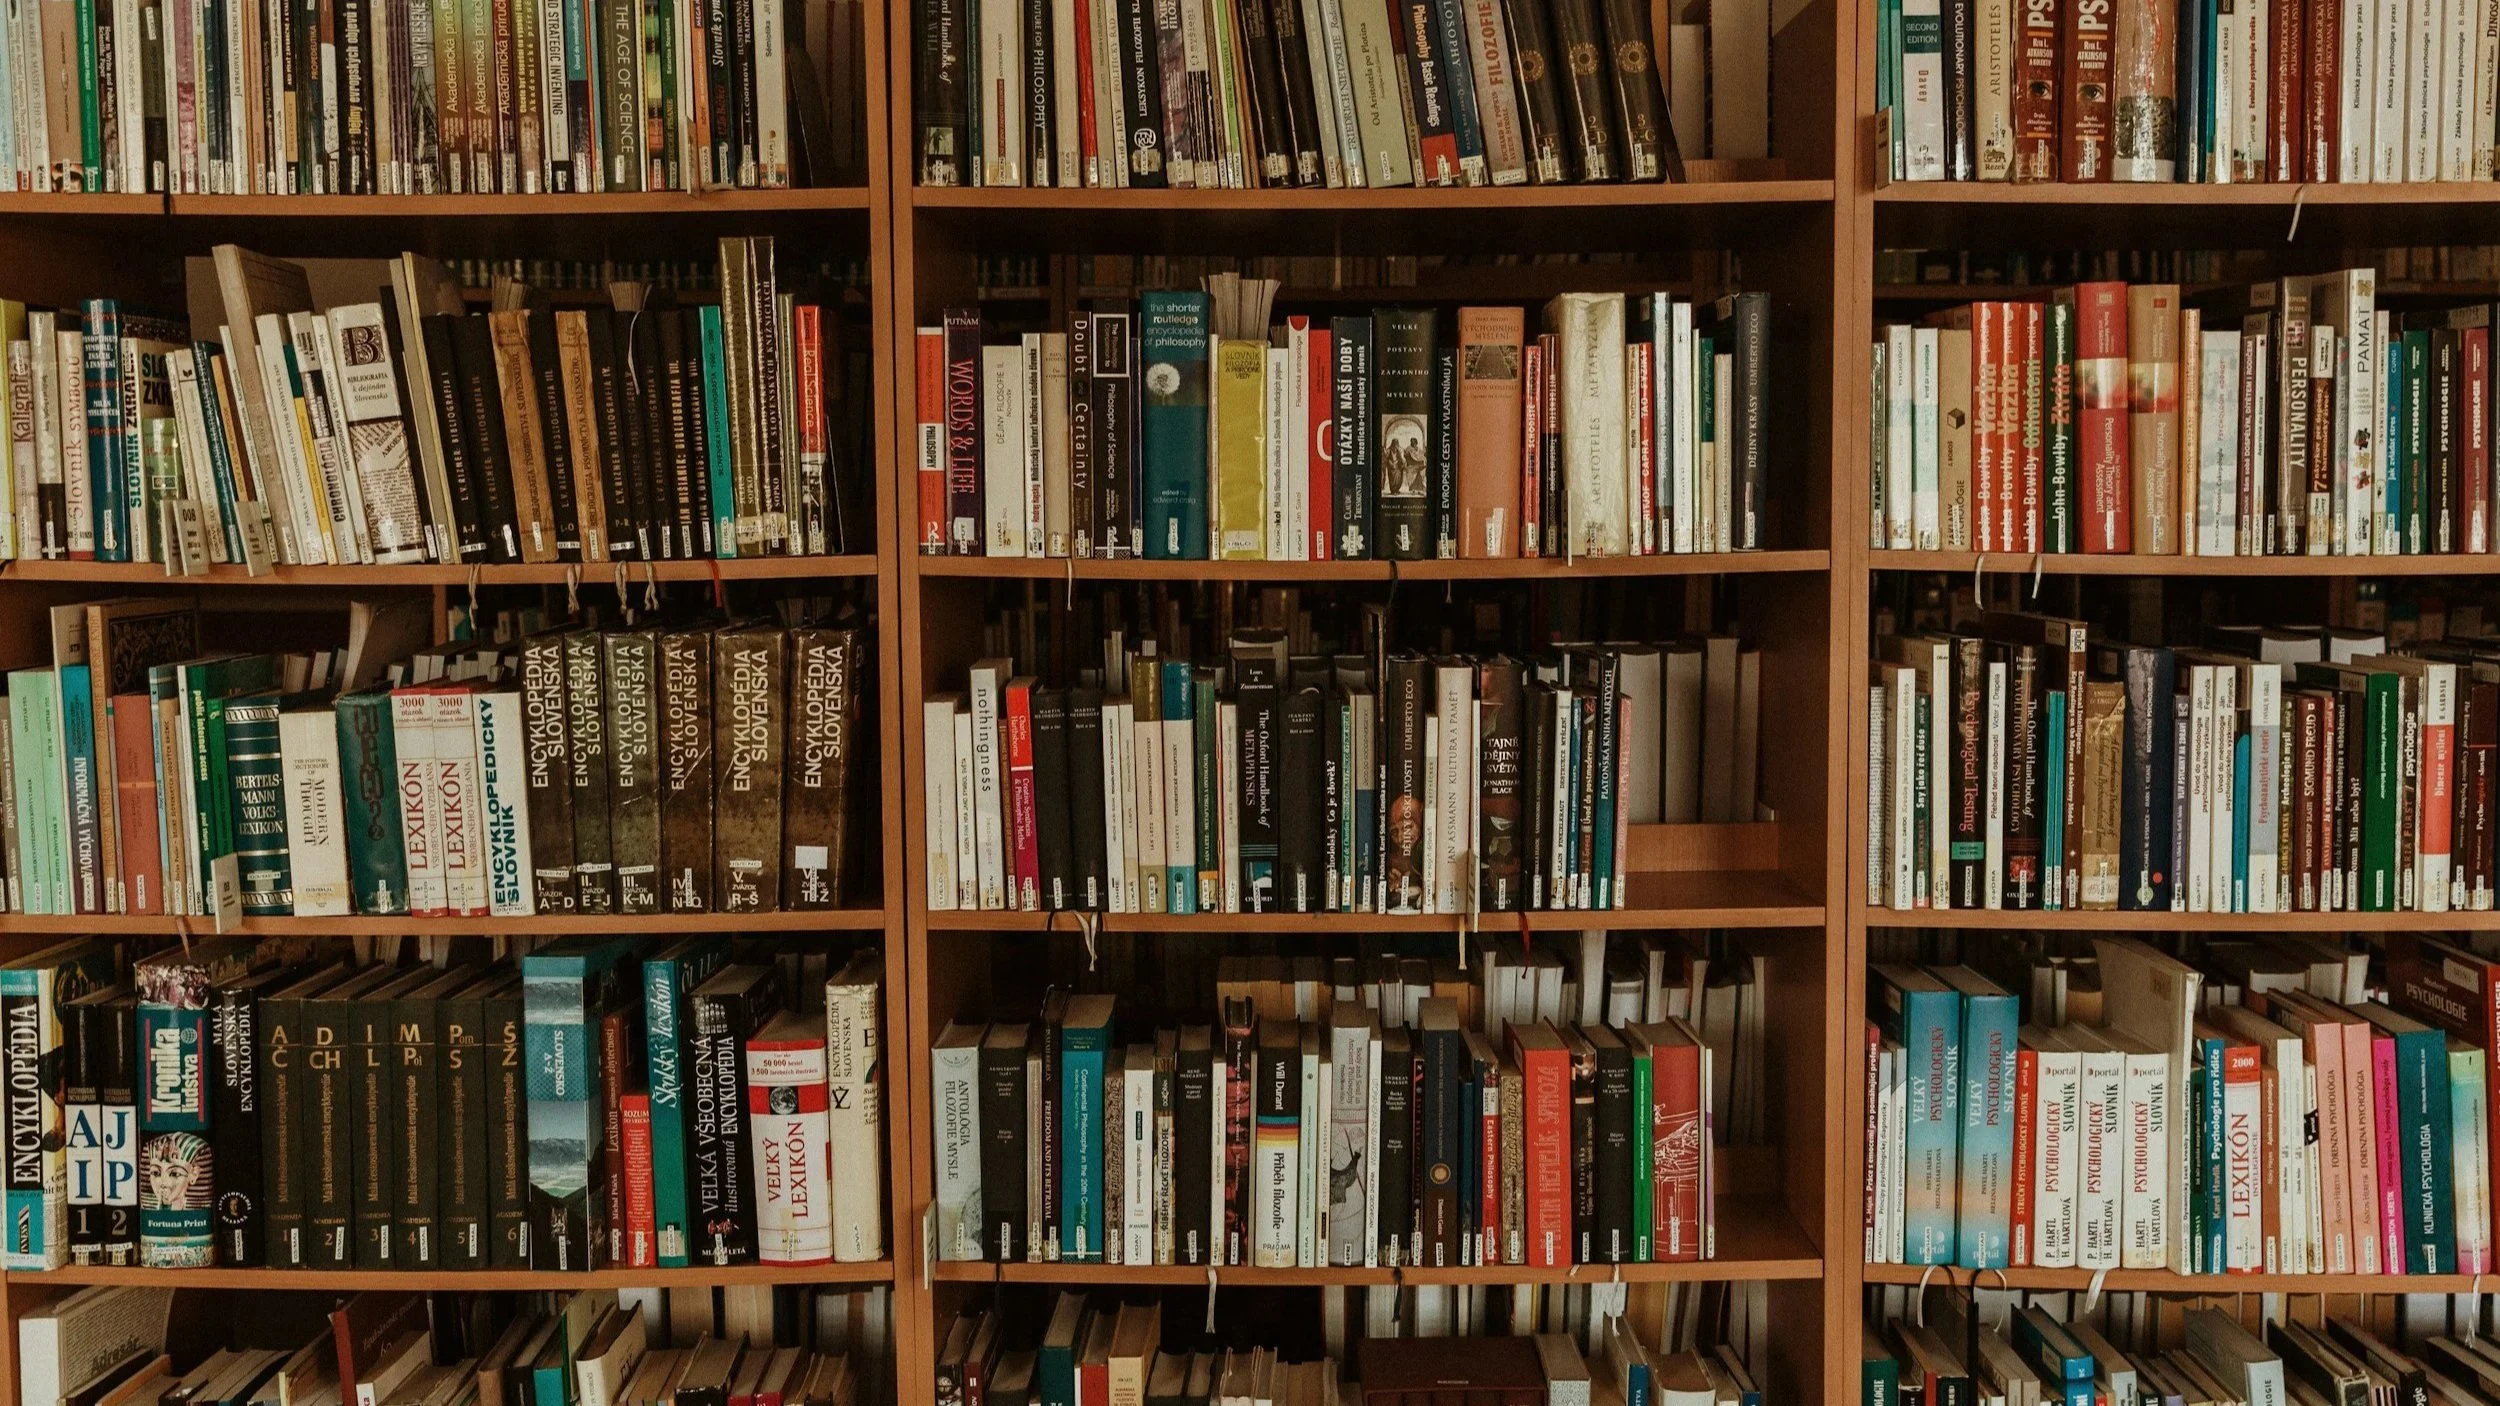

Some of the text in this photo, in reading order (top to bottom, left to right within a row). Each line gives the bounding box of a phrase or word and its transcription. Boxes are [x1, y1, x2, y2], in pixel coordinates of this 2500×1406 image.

[549, 11, 564, 115] STRATEGIC INVENTING
[941, 15, 956, 67] Handbook
[1477, 3, 1501, 86] FILOZOFIE
[1906, 23, 1938, 31] SECOND
[1907, 35, 1938, 44] EDITION
[1954, 3, 1966, 75] EVOLUTIONARY
[1990, 4, 2001, 96] ARISTOTELÉS
[2027, 48, 2054, 58] ATKINSON
[2078, 52, 2107, 61] ATKINSON
[446, 39, 459, 112] Akademická
[475, 39, 488, 113] Akademická
[499, 40, 512, 114] Akademická
[615, 6, 634, 153] THE AGE OF SCIENCE
[1033, 49, 1046, 129] PHILOSOPHY
[1137, 67, 1147, 117] LEKSYKON
[1412, 5, 1440, 128] Philosophy Basic Readings
[945, 317, 979, 326] PUTNAM
[1153, 315, 1199, 325] routledge
[1155, 337, 1207, 348] philosophy
[1167, 303, 1201, 312] shorter
[1750, 312, 1759, 334] ECO
[803, 350, 815, 428] Real Science
[1381, 368, 1429, 376] ZÁPADNÍHO
[1749, 335, 1758, 386] UMBERTO
[950, 359, 976, 494] WORDS LIFE
[1074, 320, 1089, 489] Doubt Certainty
[1106, 383, 1117, 480] Philosophy Science
[1337, 337, 1353, 466] OTÁZKY NAŠÍ DOBY
[2290, 357, 2307, 468] PERSONALITY
[2412, 378, 2420, 454] PSYCHOLOGIE
[2441, 375, 2449, 452] PSYCHOLOGIE
[2472, 380, 2480, 449] PSYCHOLOGIE
[129, 429, 142, 508] SLOVNÍK
[926, 425, 936, 468] PHILOSOPHY
[1441, 463, 1451, 509] EVROPSKÉ
[400, 697, 425, 708] 3000
[437, 697, 463, 708] 3000
[523, 645, 549, 788] ENCYKLOPÉDIA
[543, 645, 565, 757] SLOVENSKA
[568, 646, 588, 787] ENCYKLOPÉDIA
[583, 646, 600, 756] SLOVENSKA
[616, 646, 634, 787] ENCYKLOPÉDIA
[632, 646, 647, 756] SLOVENSKA
[668, 650, 685, 791] ENCYKLOPÉDIA
[684, 650, 698, 759] SLOVENSKA
[730, 650, 750, 792] ENCYKLOPÉDIA
[752, 650, 768, 762] SLOVENSKA
[804, 646, 825, 788] ENCYKLOPÉDIA
[823, 646, 843, 758] SLOVENSKA
[1404, 705, 1413, 751] UMBERTO
[976, 688, 991, 793] nothingness
[1245, 729, 1256, 806] METAPHYSICS
[1259, 709, 1270, 815] The Oxford Handbook
[1484, 750, 1520, 761] DĚJINY
[1486, 737, 1519, 747] TAJNÉ
[1960, 691, 1980, 833] Psychological Testing
[2025, 699, 2037, 804] The Oxford Handbook
[2406, 712, 2415, 777] psychologie
[236, 773, 282, 788] BERTELS-
[242, 790, 275, 803] MANN
[242, 806, 280, 819] VOLKS-
[403, 762, 428, 871] LEXIKÓN
[441, 762, 466, 871] LEXIKÓN
[479, 699, 505, 905] ENCYKLOPEDICKÝ
[240, 821, 283, 835] LEXIKON
[500, 805, 520, 905] SLOVNÍK
[271, 1025, 288, 1044] A
[309, 1050, 341, 1069] CH
[316, 1027, 334, 1046] D
[368, 1049, 380, 1067] L
[400, 1024, 421, 1043] M
[450, 1050, 462, 1068] S
[503, 1021, 516, 1043] Š
[554, 1030, 564, 1096] SLOVENSKO
[2232, 1058, 2254, 1067] 2000
[7, 1003, 42, 1183] ENCYKLOPÉDIA
[150, 1028, 182, 1113] Kronika
[1275, 1061, 1286, 1110] Will Durant
[1946, 1045, 1959, 1108] SLOVNÍK
[2004, 1050, 2017, 1113] SLOVNÍK
[2062, 1082, 2076, 1132] SLOVNÍK
[945, 1081, 958, 1137] FILOZOFIE
[958, 1080, 970, 1147] ANTOLÓGIA
[1079, 1068, 1089, 1154] Continental Philosophy
[2104, 1083, 2118, 1133] SLOVNÍK
[2150, 1082, 2164, 1133] SLOVNÍK
[788, 1122, 808, 1218] LEXIKÓN
[2045, 1100, 2061, 1192] PSYCHOLOGICKÝ
[2087, 1101, 2103, 1193] PSYCHOLOGICKÝ
[2133, 1101, 2149, 1193] PSYCHOLOGICKÝ
[2232, 1113, 2250, 1219] LEXIKÓN
[77, 1208, 90, 1234] 1
[112, 1208, 127, 1235] 2
